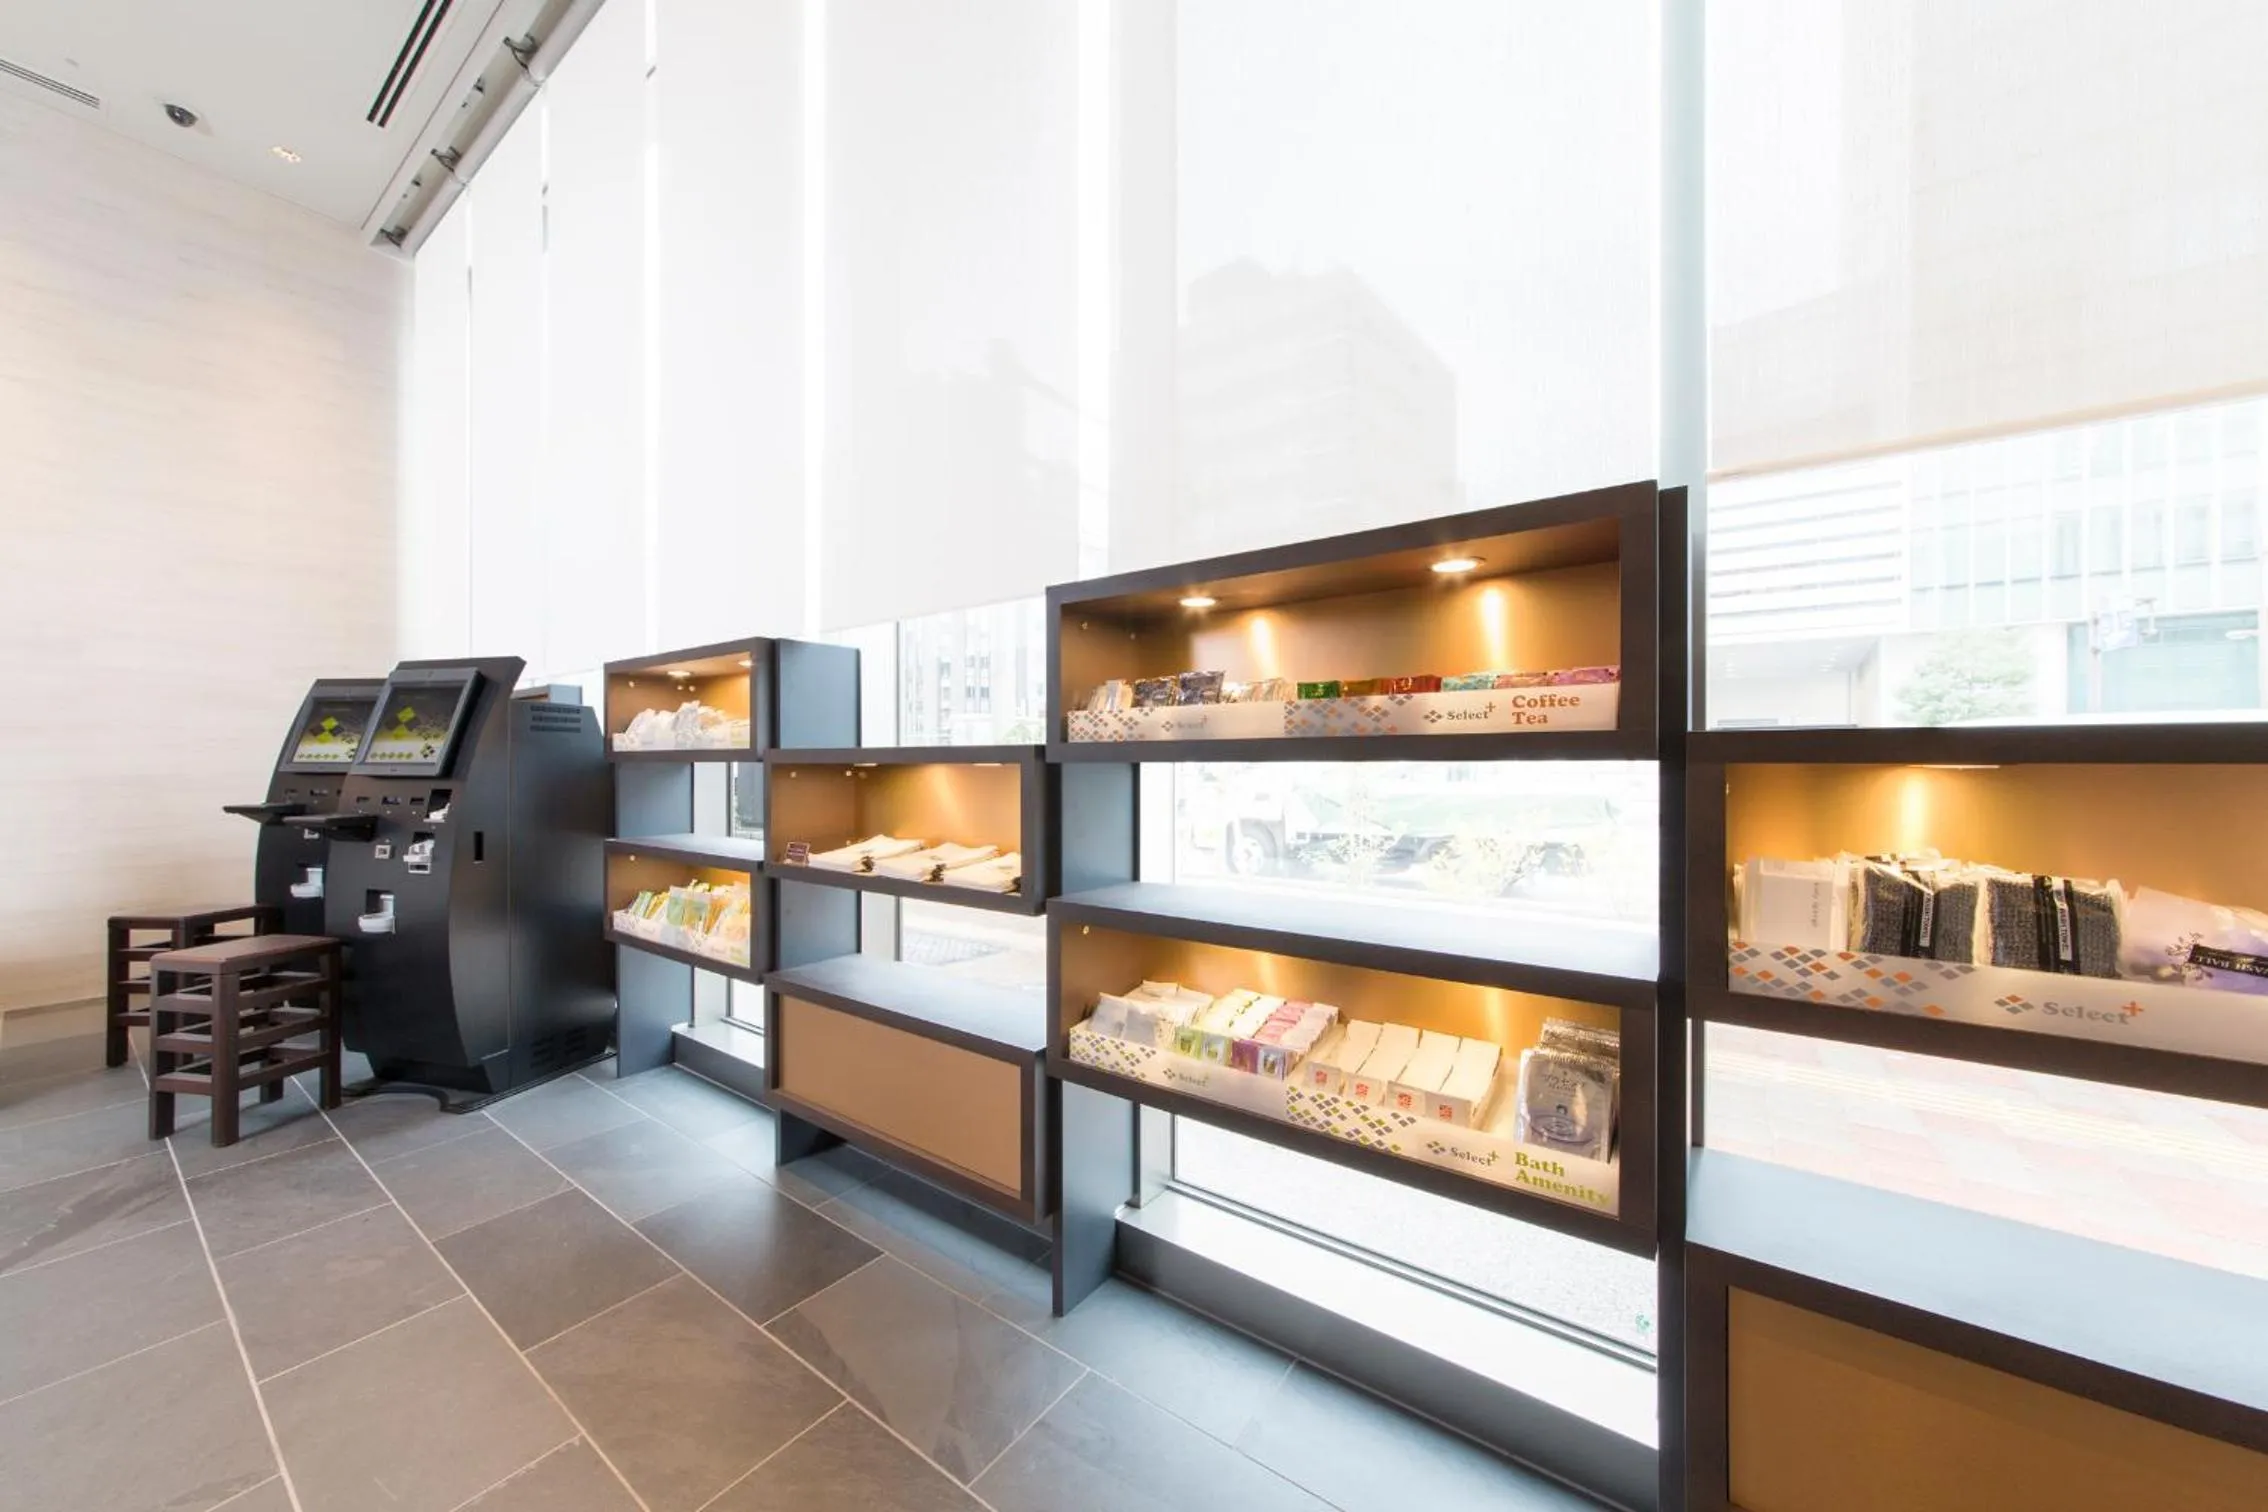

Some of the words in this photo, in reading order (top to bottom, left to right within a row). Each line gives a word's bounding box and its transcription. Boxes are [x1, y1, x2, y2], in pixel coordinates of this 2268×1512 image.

[1511, 694, 1581, 709] Coffee
[1511, 711, 1549, 725] Tea
[1515, 1151, 1566, 1178] Bath
[1515, 1169, 1611, 1205] Amenity
